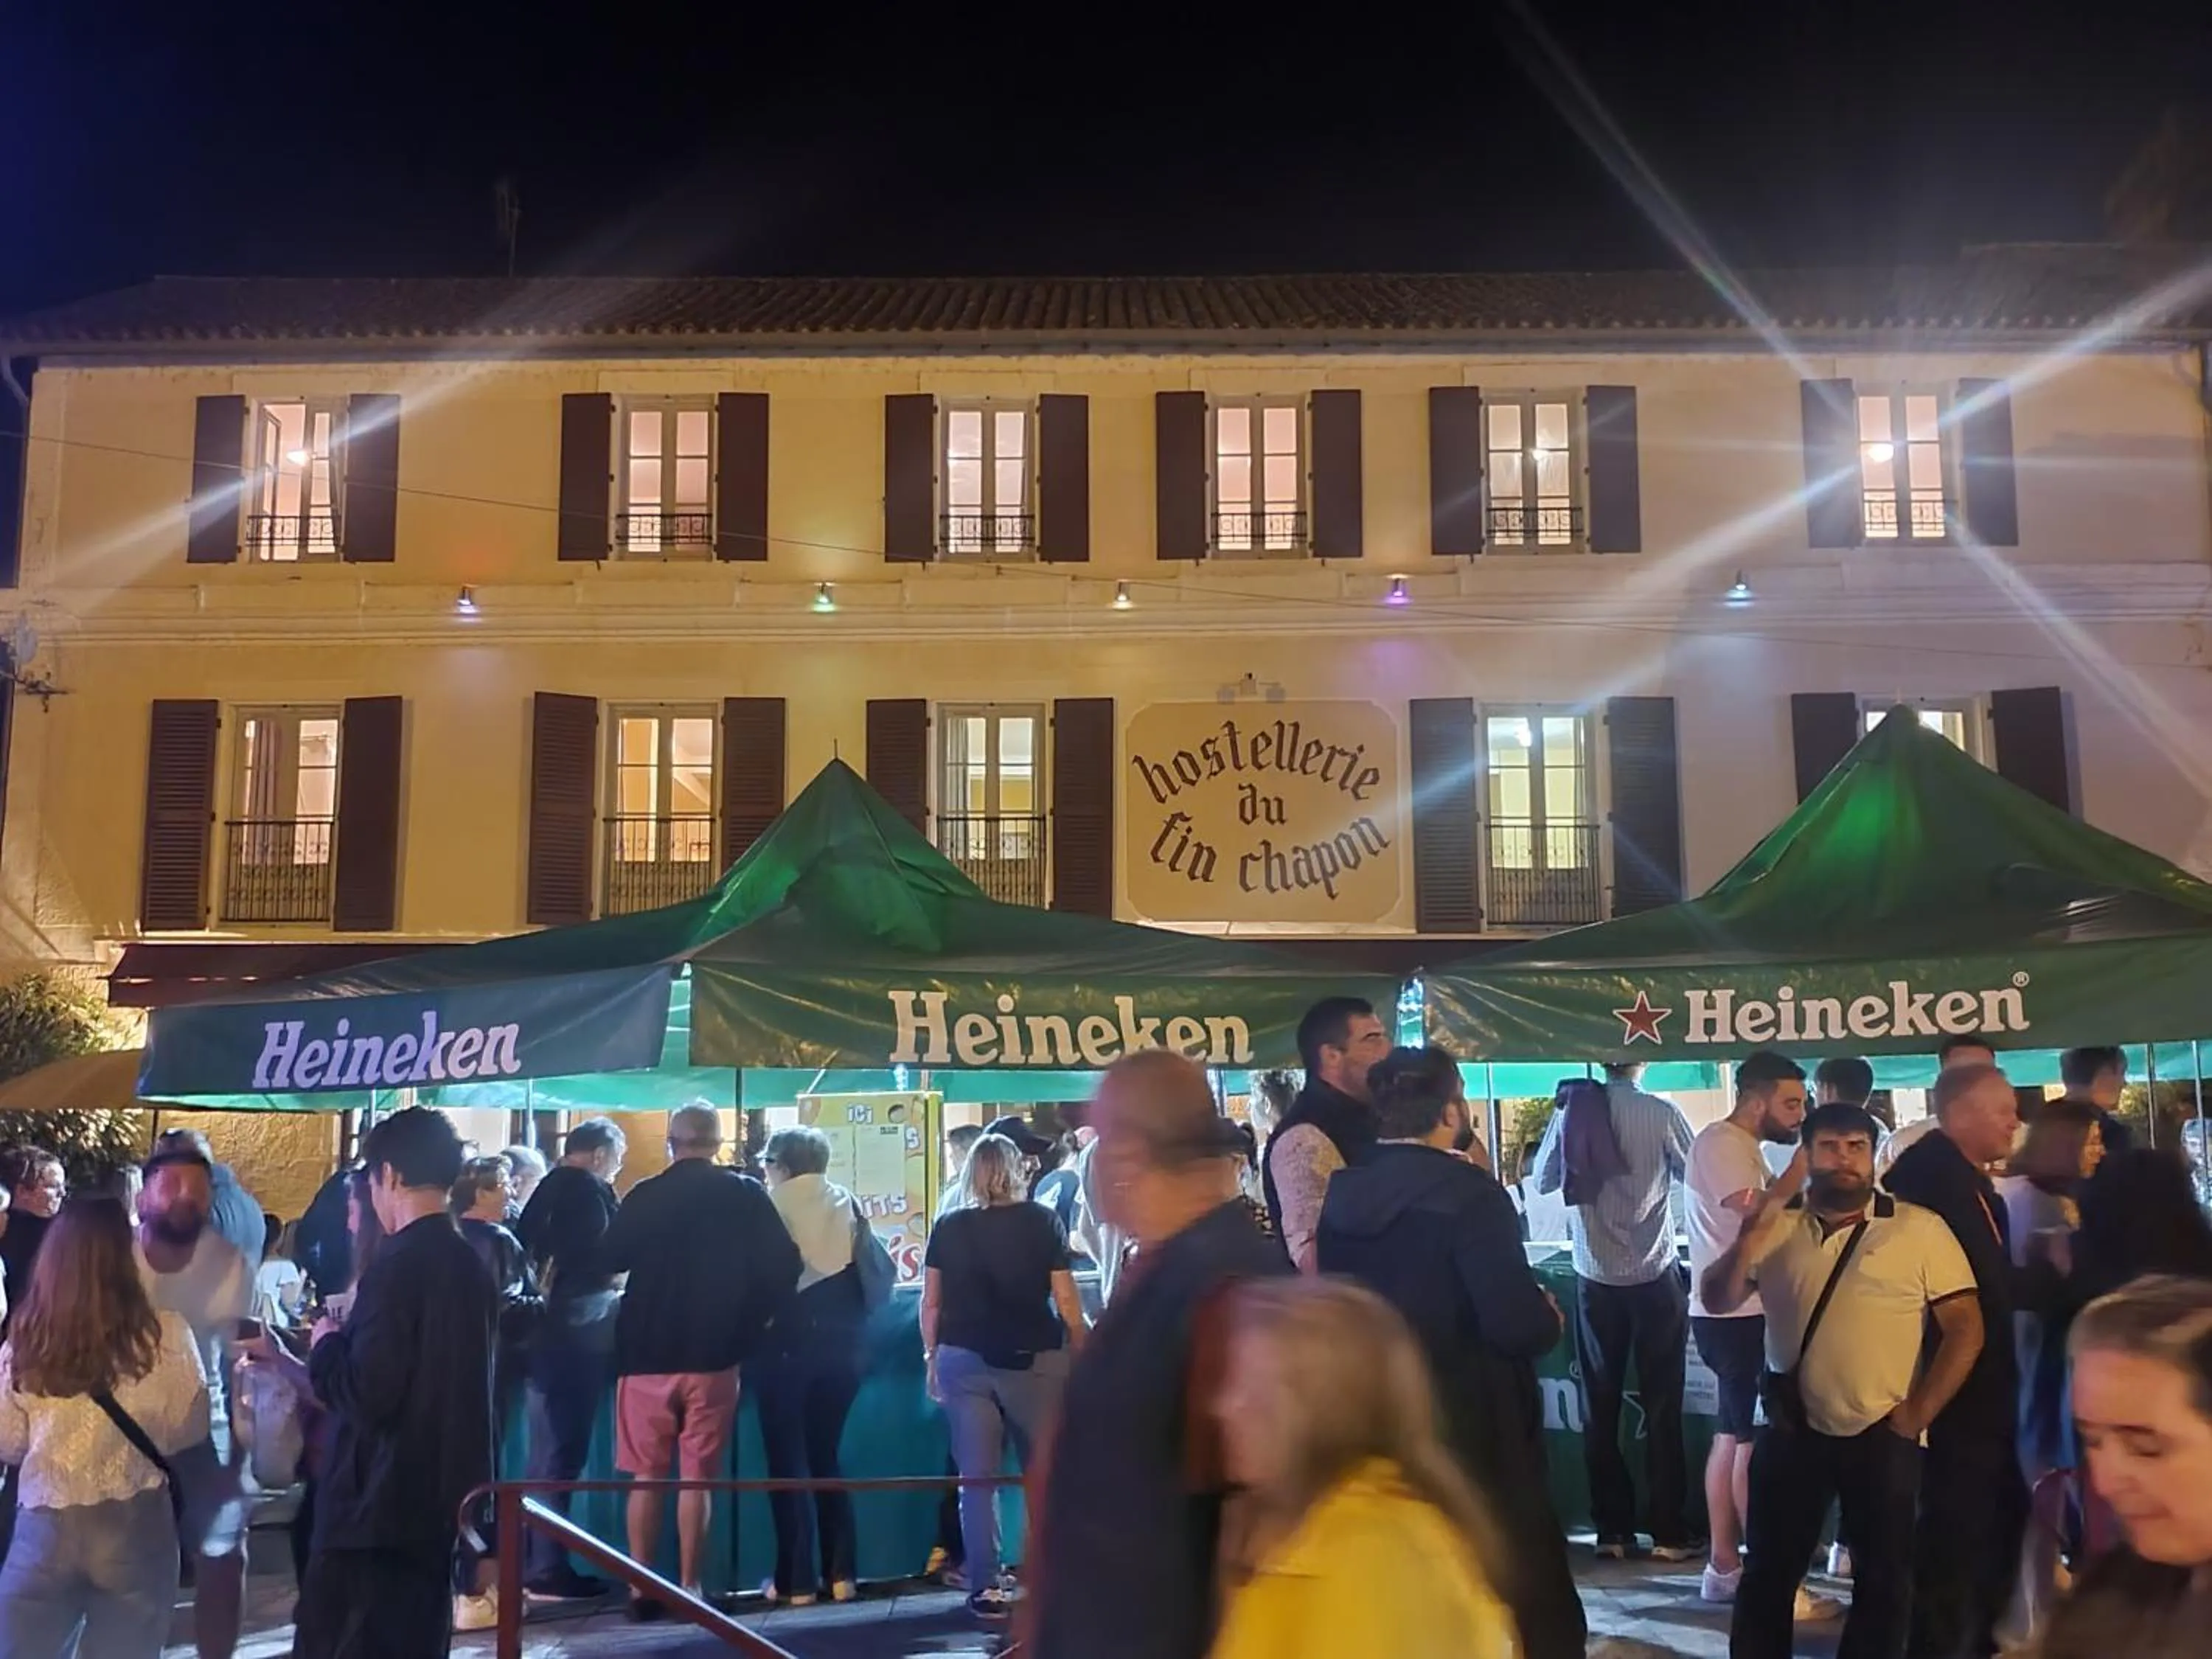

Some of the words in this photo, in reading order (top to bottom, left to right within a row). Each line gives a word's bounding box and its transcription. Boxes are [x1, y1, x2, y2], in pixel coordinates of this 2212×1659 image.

[1133, 720, 1380, 804] hostellerie
[1238, 782, 1289, 826] du
[1150, 811, 1217, 883] fin
[1238, 816, 1391, 900] chapon
[252, 1010, 521, 1088] Heineken
[888, 990, 1253, 1065] Heineken
